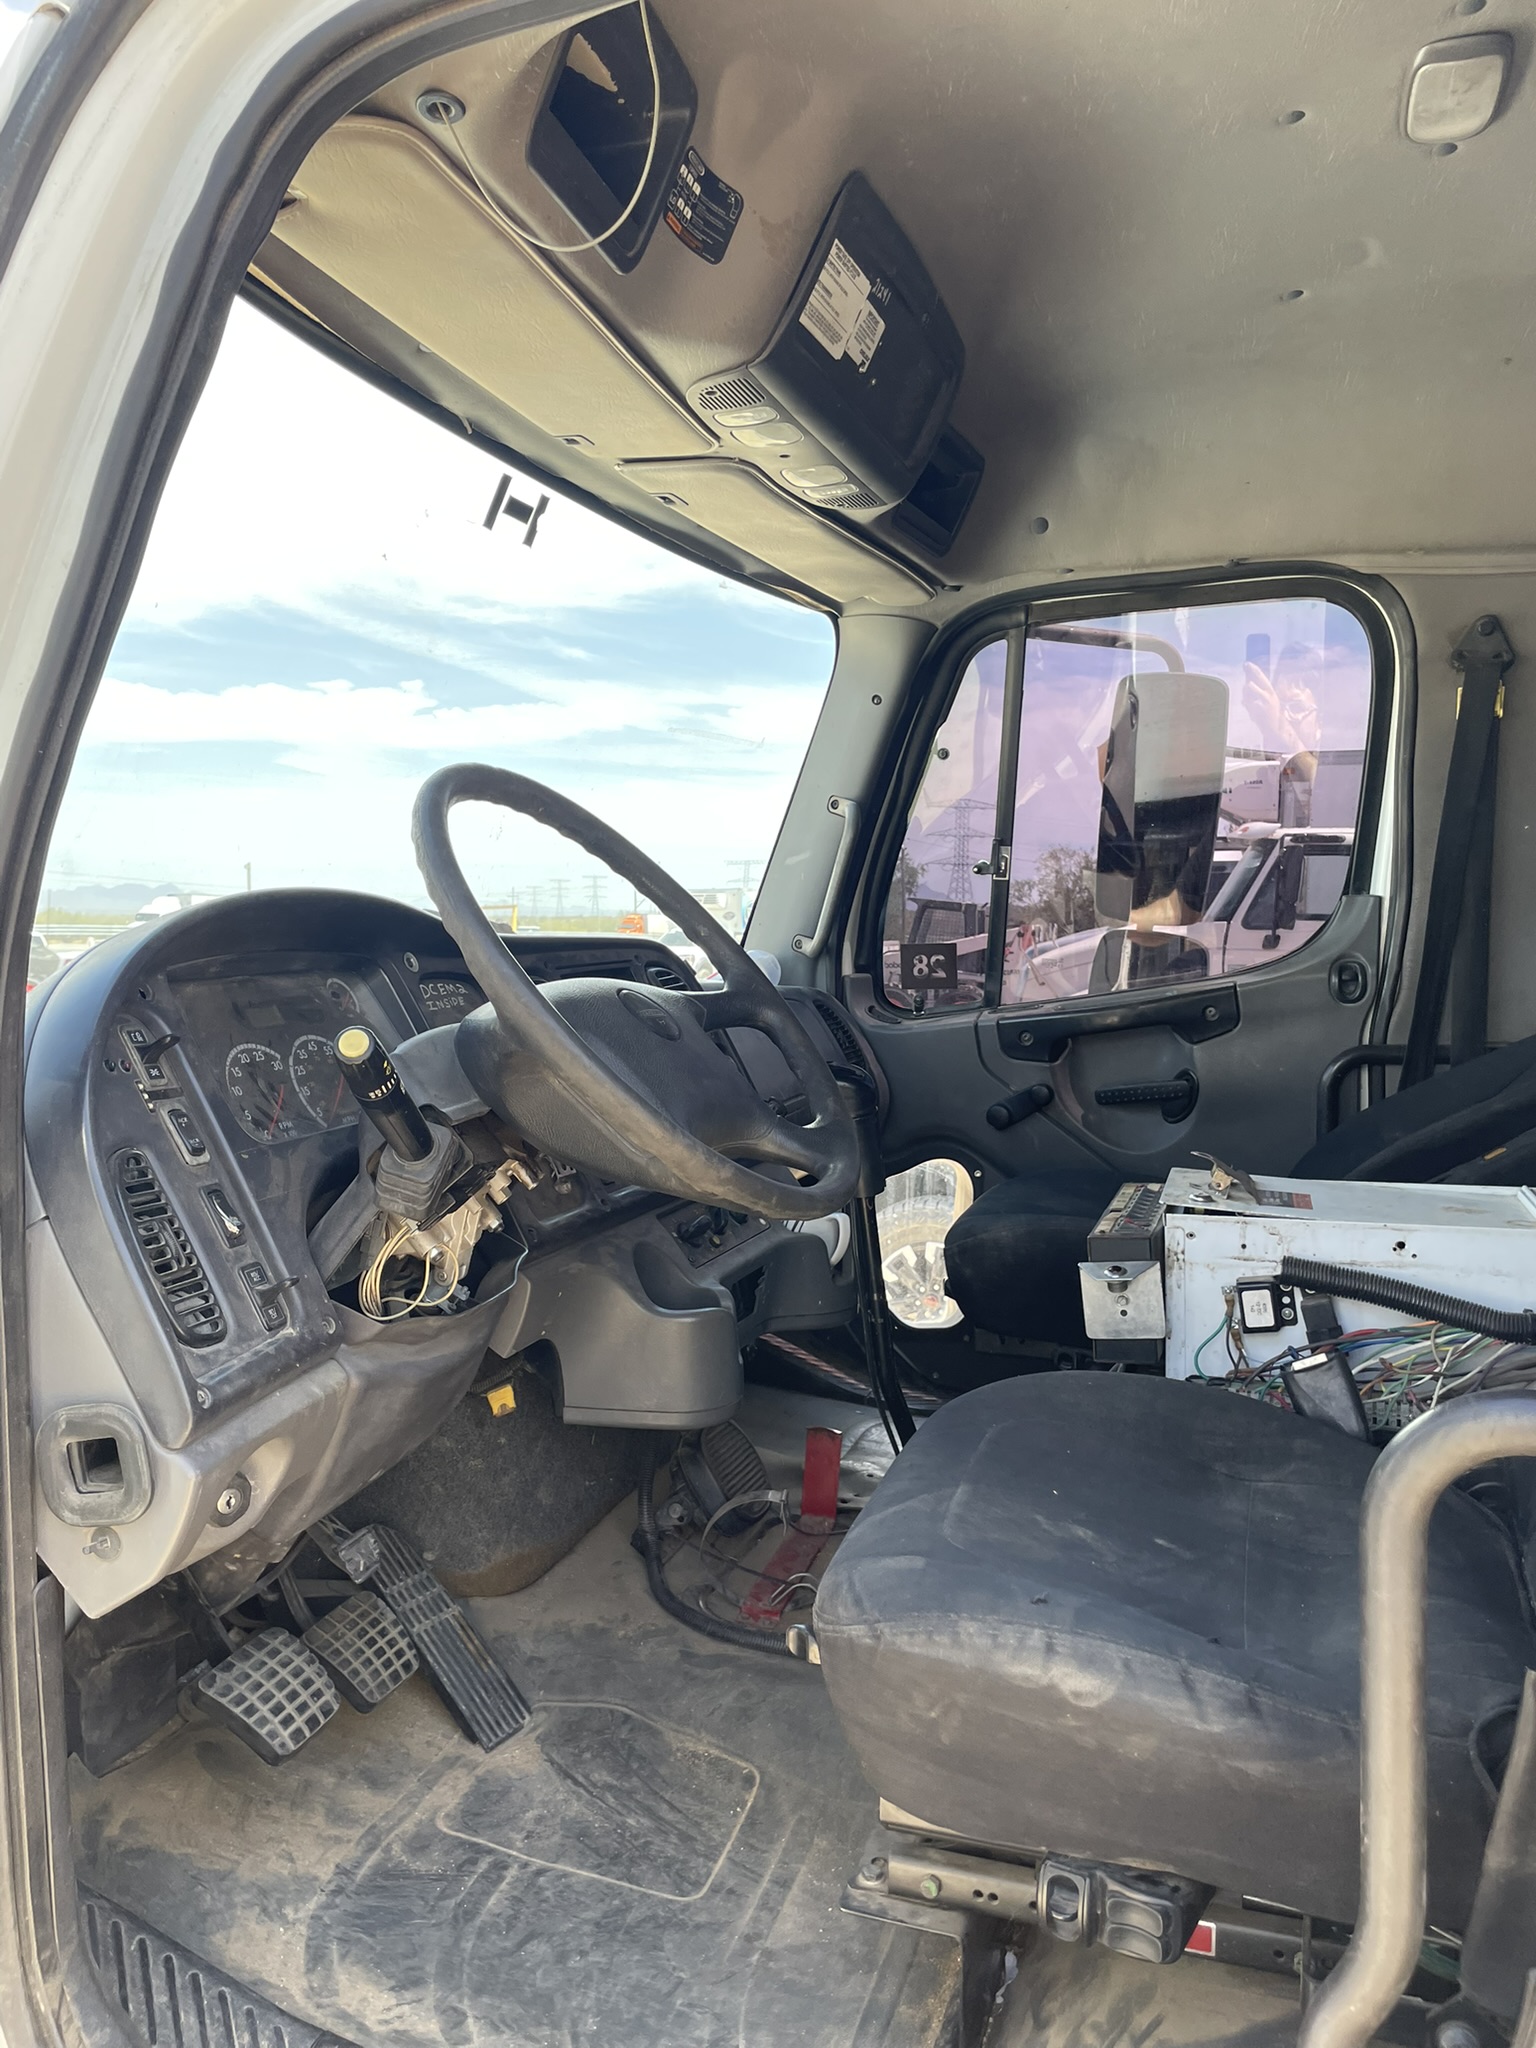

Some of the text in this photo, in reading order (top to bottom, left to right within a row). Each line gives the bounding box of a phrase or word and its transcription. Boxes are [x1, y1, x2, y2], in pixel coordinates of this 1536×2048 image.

[419, 983, 469, 999] DCEM2
[307, 1041, 318, 1052] 45
[323, 1045, 334, 1056] 55
[238, 1052, 250, 1064] 20
[252, 1050, 265, 1062] 25
[296, 1049, 308, 1060] 35
[270, 1060, 283, 1071] 30
[294, 1065, 306, 1076] 25
[230, 1066, 242, 1078] 15
[231, 1085, 243, 1097] 10
[300, 1086, 311, 1097] 15
[244, 1110, 252, 1120] 5
[316, 1107, 323, 1117] 5
